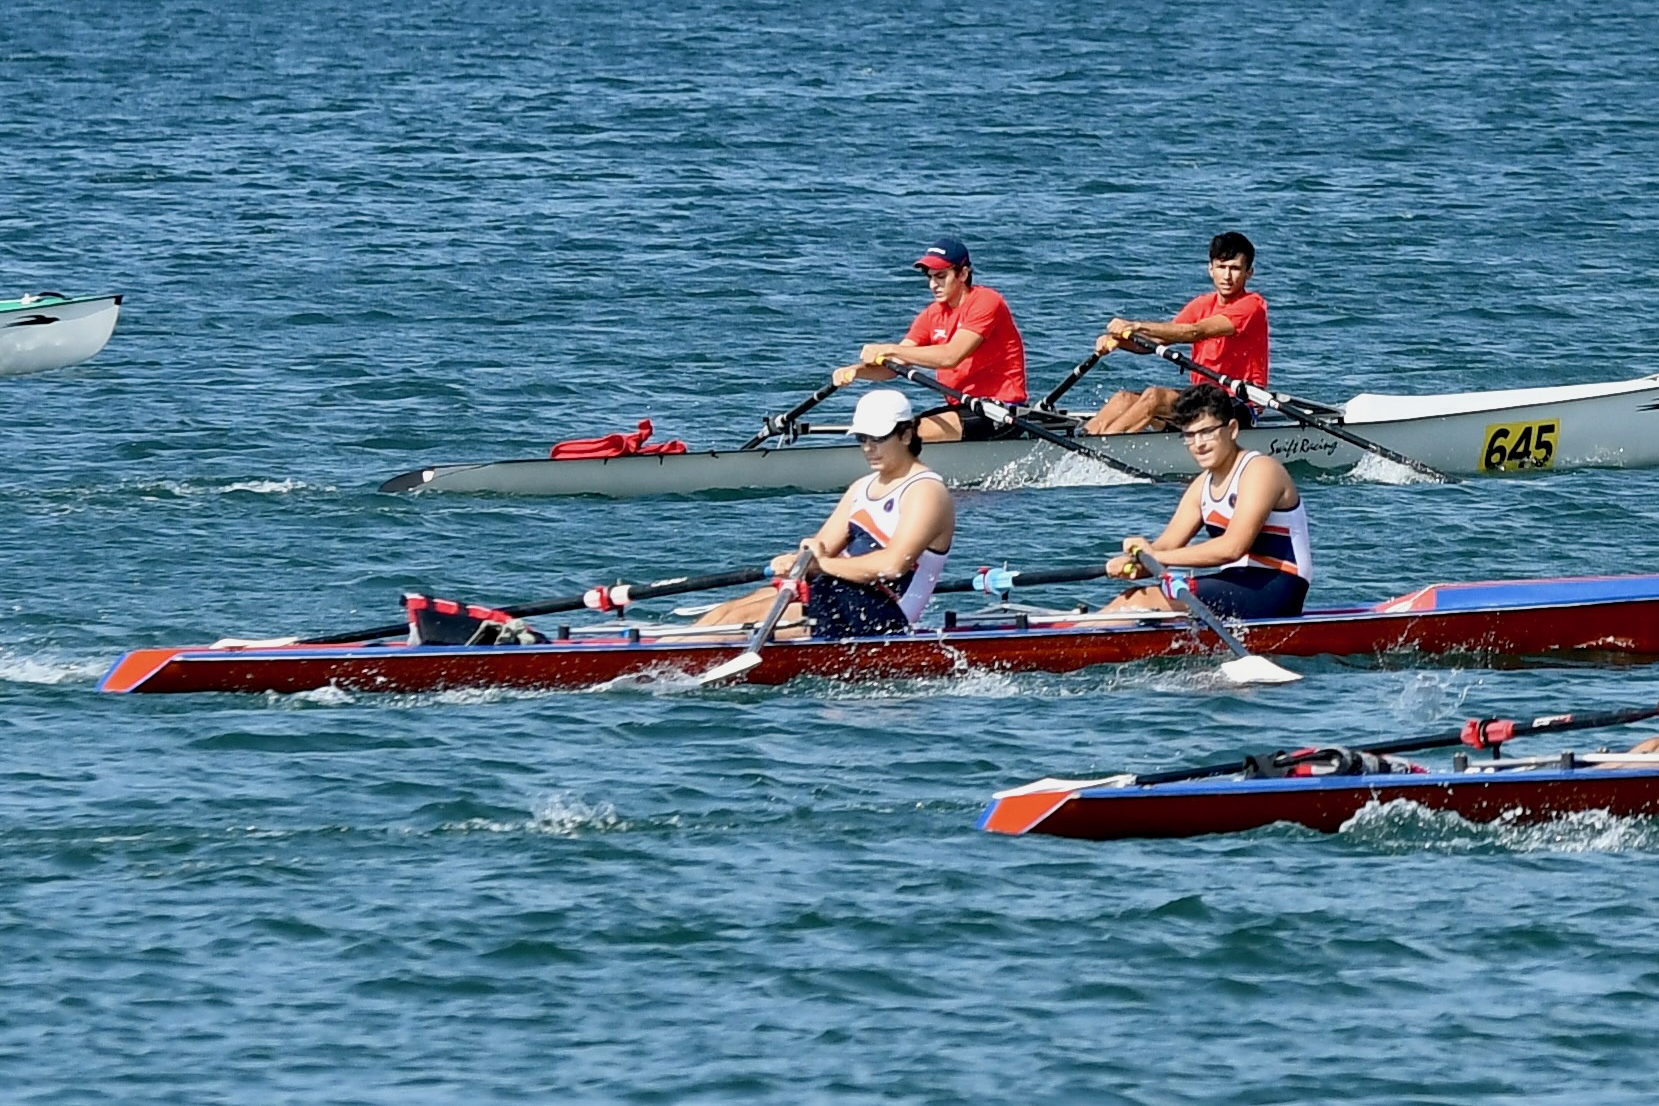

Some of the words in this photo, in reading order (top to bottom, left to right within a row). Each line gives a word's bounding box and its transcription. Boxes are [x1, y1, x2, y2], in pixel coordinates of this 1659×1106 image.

[1268, 438, 1299, 458] Swift
[1300, 438, 1338, 456] Racing
[1484, 423, 1556, 470] 645
